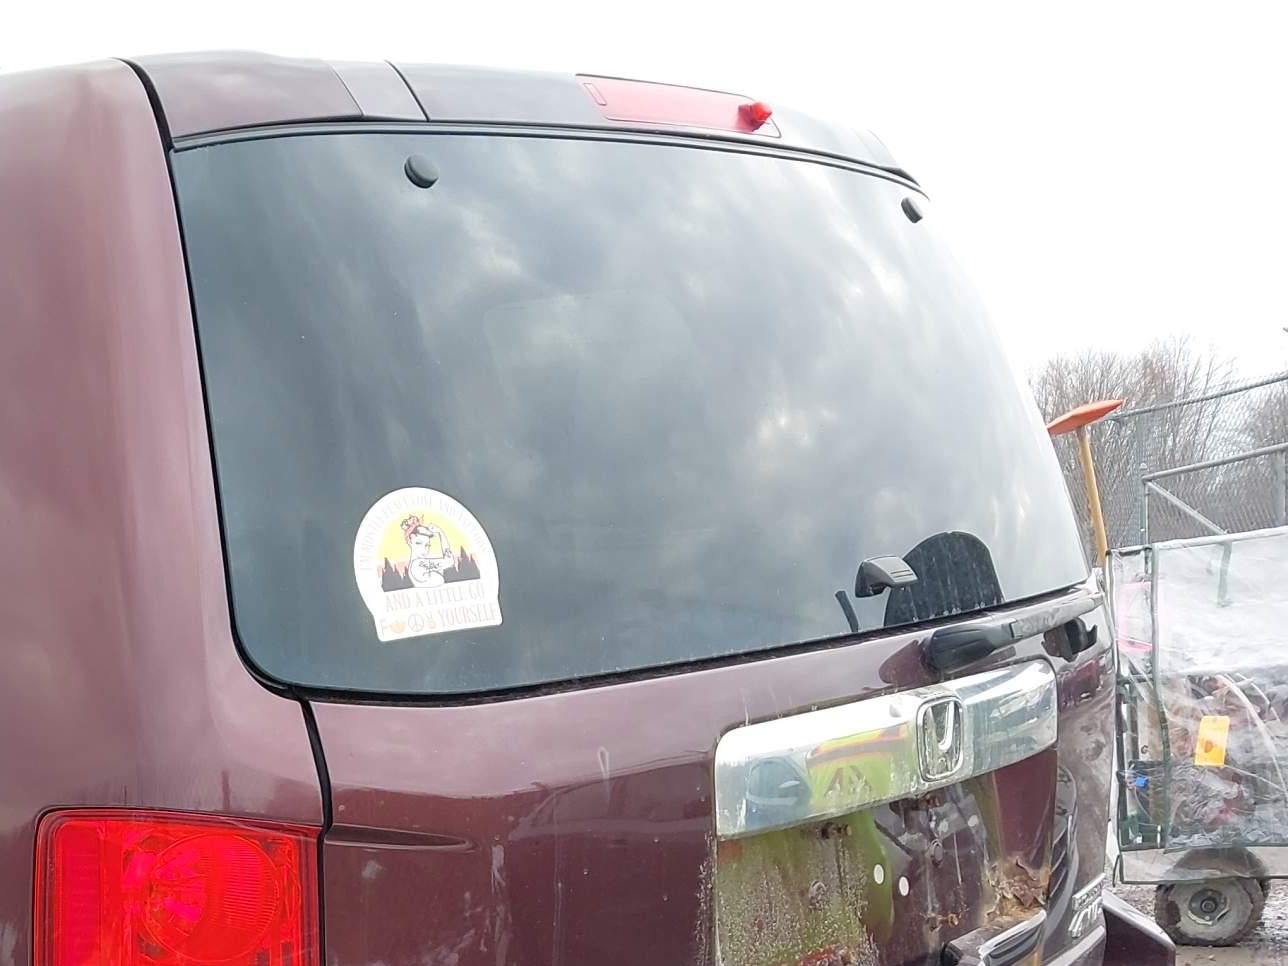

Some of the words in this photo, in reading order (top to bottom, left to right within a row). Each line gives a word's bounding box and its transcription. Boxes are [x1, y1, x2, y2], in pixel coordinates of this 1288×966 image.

[385, 594, 411, 612] AND
[415, 593, 425, 608] A
[426, 586, 465, 607] LITTLE
[469, 581, 485, 601] GO
[439, 602, 497, 627] YOURSELF
